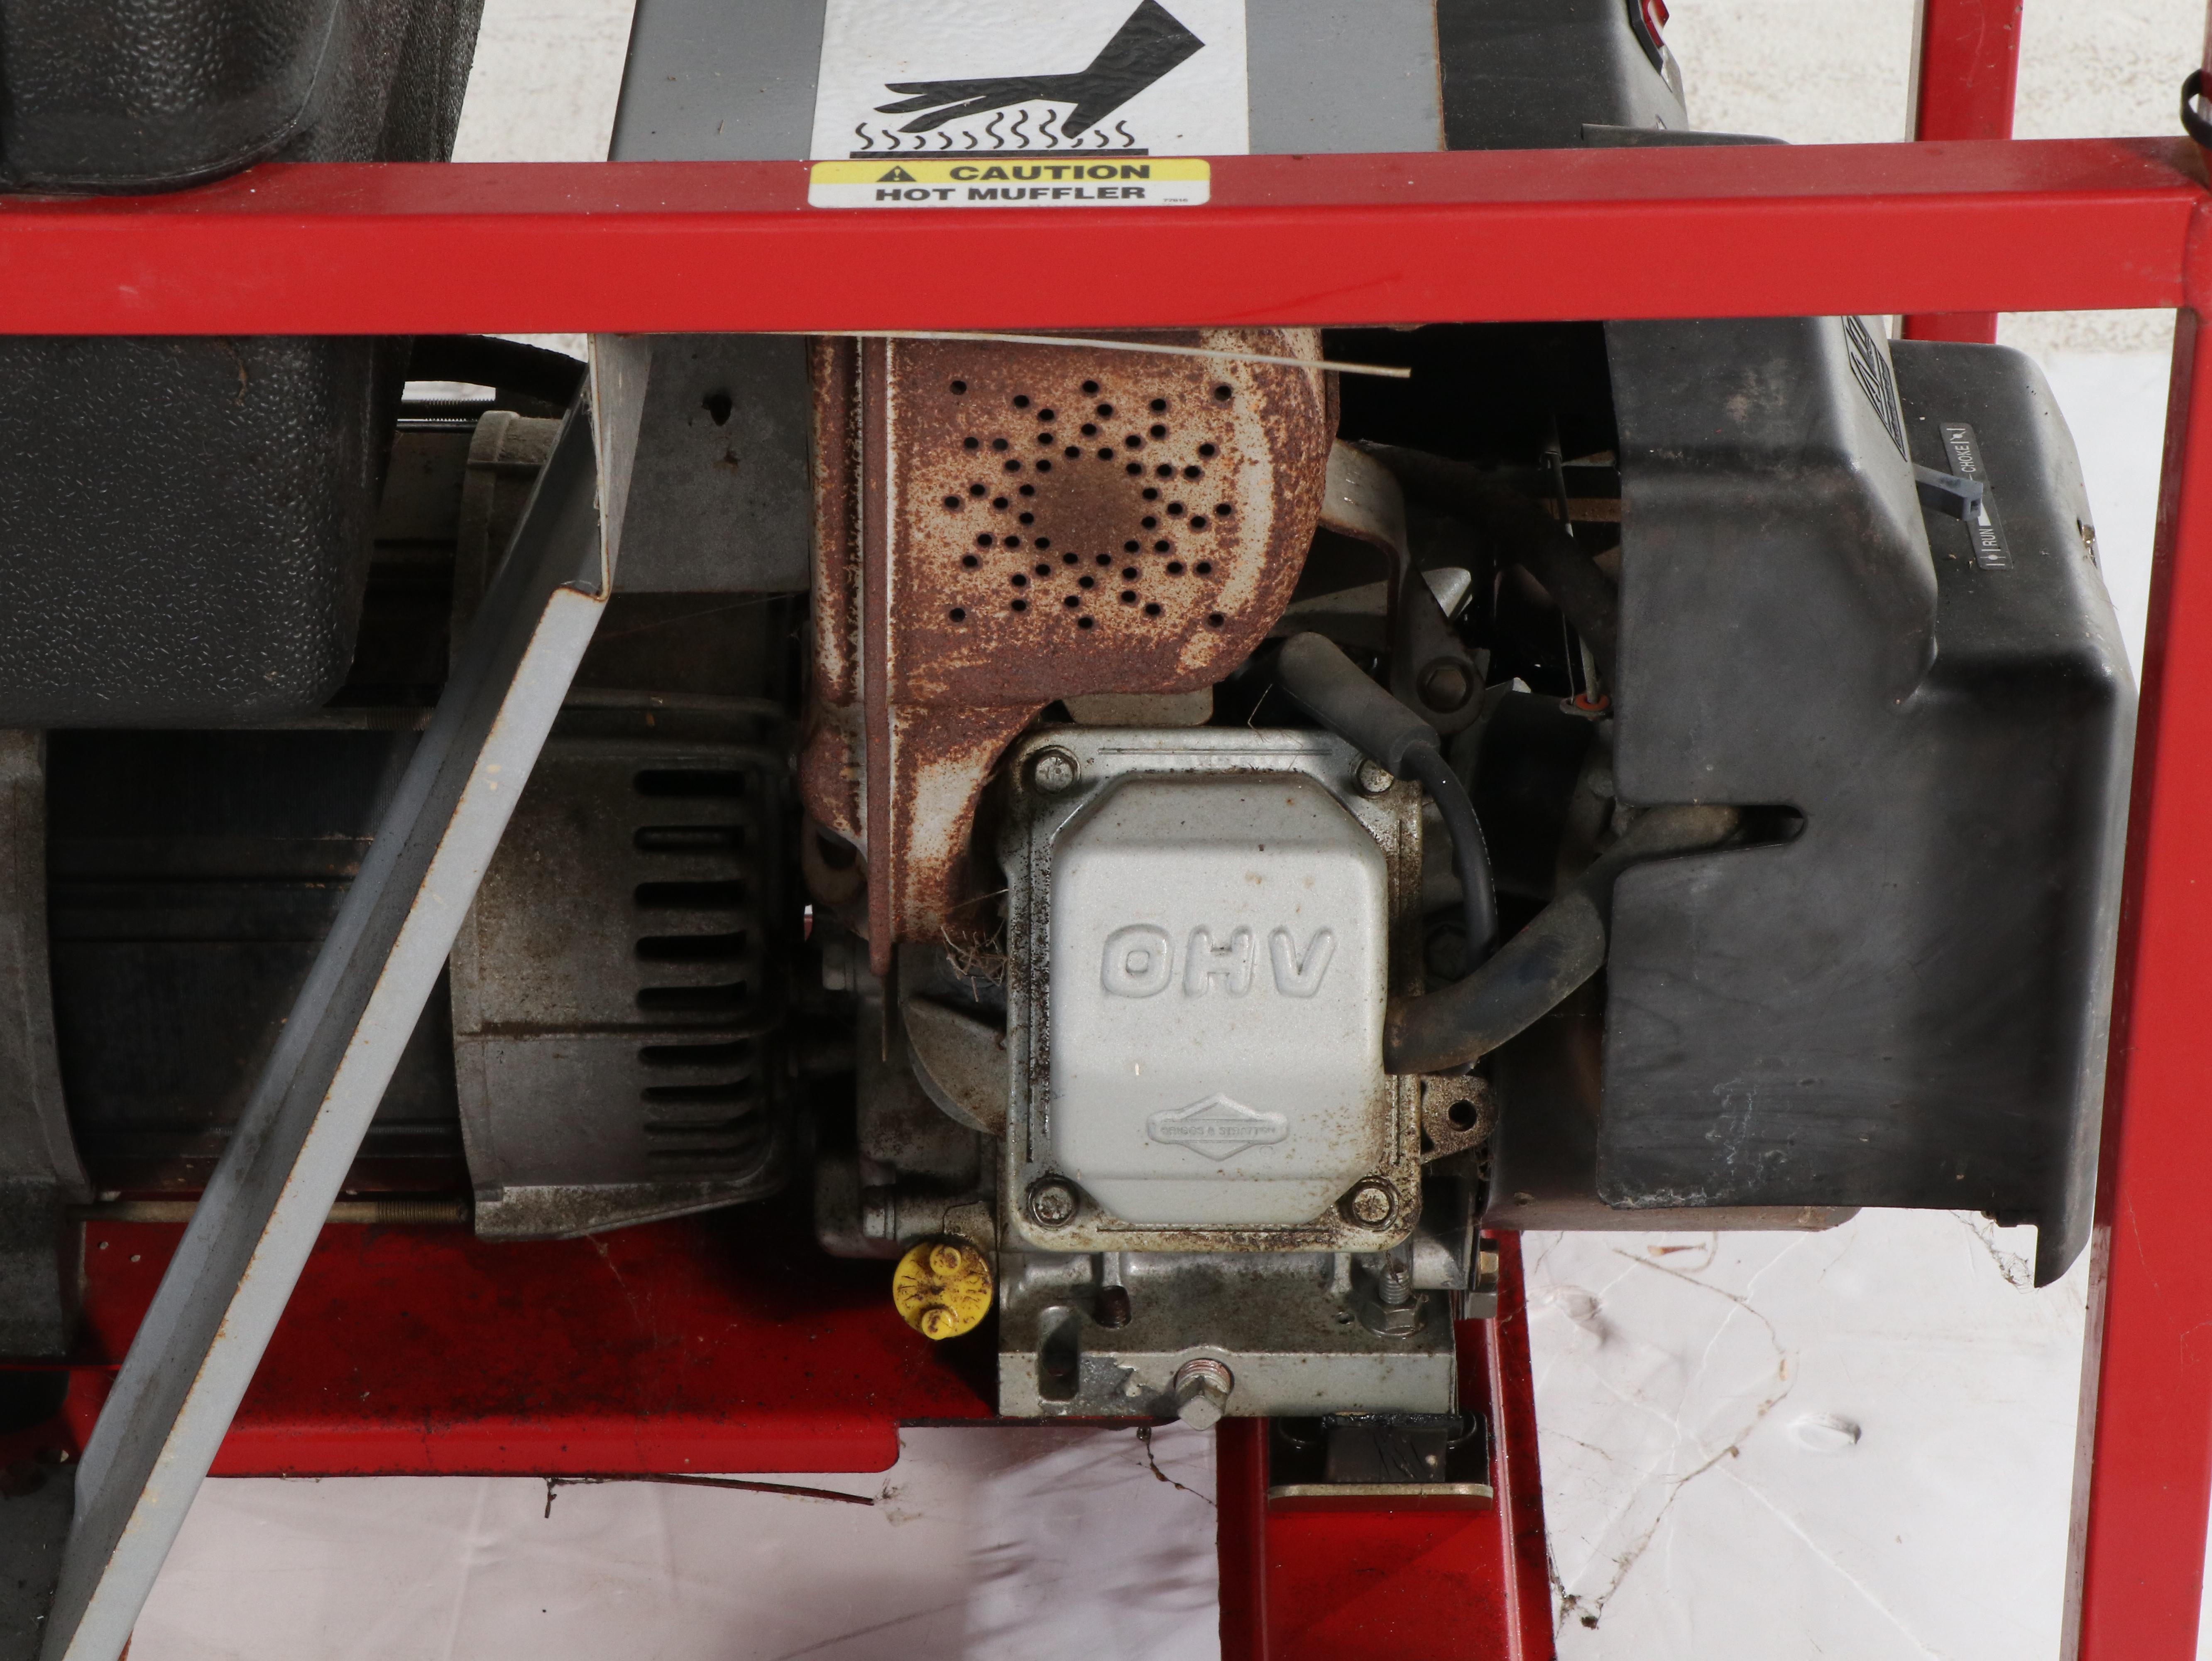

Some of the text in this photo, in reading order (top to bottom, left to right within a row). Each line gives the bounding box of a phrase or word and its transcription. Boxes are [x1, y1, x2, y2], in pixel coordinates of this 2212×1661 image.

[950, 165, 1149, 180] CAUTION
[876, 187, 1145, 201] HOT MUFFLER
[1955, 445, 1976, 473] CHOKE
[1979, 528, 1998, 546] RUN
[1101, 923, 1336, 998] OHV
